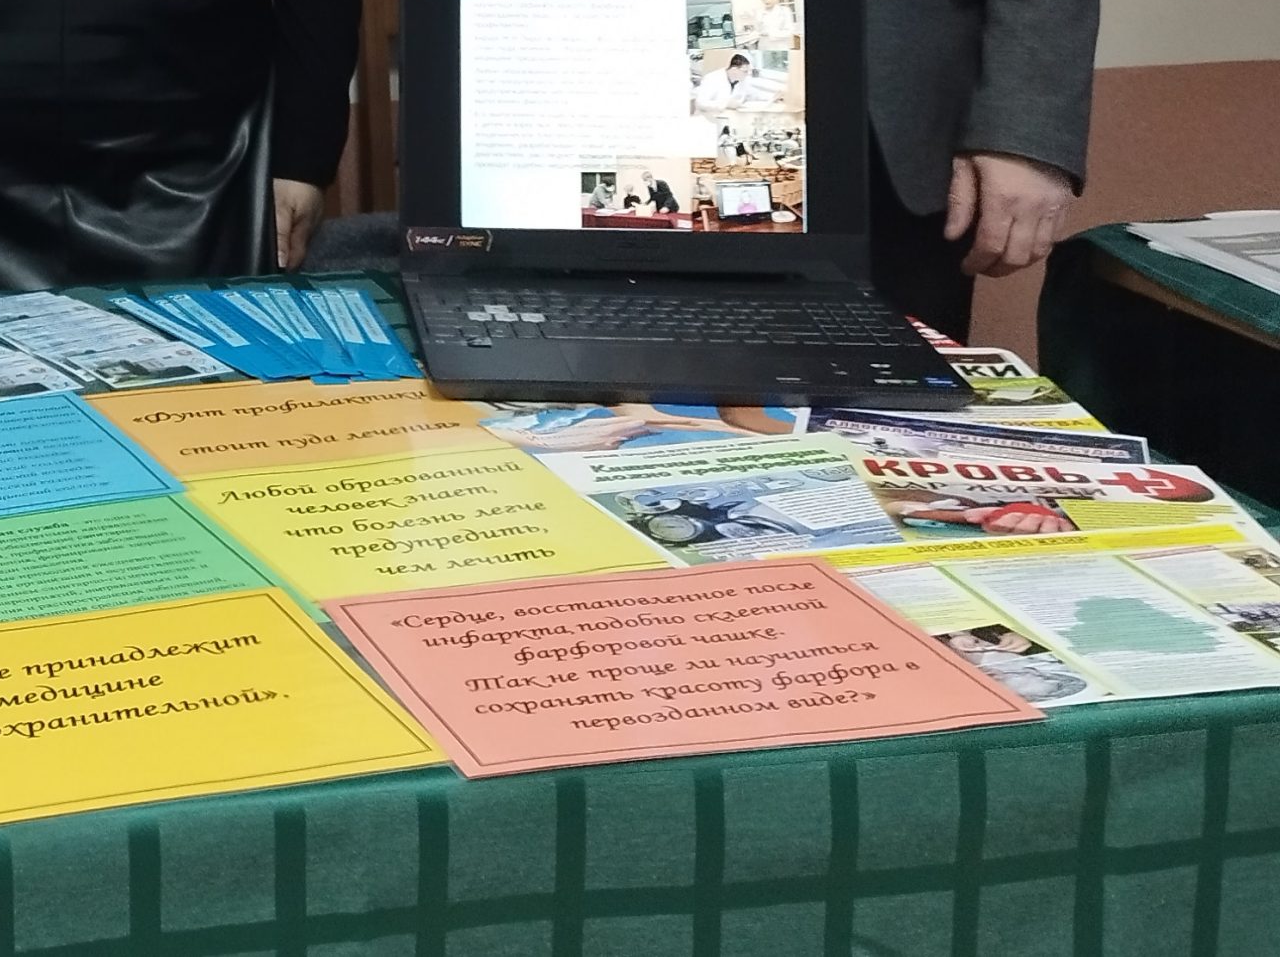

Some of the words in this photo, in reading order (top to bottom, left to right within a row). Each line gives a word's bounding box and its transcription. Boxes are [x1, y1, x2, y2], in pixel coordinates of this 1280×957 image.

[133, 407, 225, 425] «Фунт
[233, 389, 427, 414] профилактики
[179, 437, 269, 456] стоит
[277, 432, 338, 449] пуда
[346, 421, 460, 440] лечения»
[217, 482, 317, 507] Любой
[325, 460, 524, 496] образованный
[863, 458, 1092, 484] КРОВЬ
[286, 495, 395, 515] человек
[404, 483, 498, 506] знает,
[283, 523, 343, 539] что
[352, 509, 466, 532] болезнь
[475, 501, 547, 521] легче
[330, 521, 549, 559] предупредить,
[375, 562, 437, 578] чем
[447, 547, 556, 572] лечить
[389, 603, 506, 632] «Сердце,
[513, 585, 738, 618] восстановленное
[746, 578, 815, 596] после
[422, 622, 572, 653] инфаркта,
[578, 608, 685, 635] подобно
[693, 596, 827, 624] склеенной
[22, 631, 261, 682] принадлежит
[464, 672, 544, 695] Так
[548, 670, 581, 685] не
[588, 659, 677, 682] проще
[685, 657, 721, 672] ли
[726, 639, 879, 670] научиться
[513, 632, 685, 667] фарфоровой
[691, 626, 785, 647] чашке.
[475, 688, 634, 717] сохранять
[642, 675, 762, 702] красоту
[772, 659, 899, 693] фарфора
[905, 660, 920, 673] в
[570, 699, 779, 731] первозданном
[786, 688, 877, 711] виде?»
